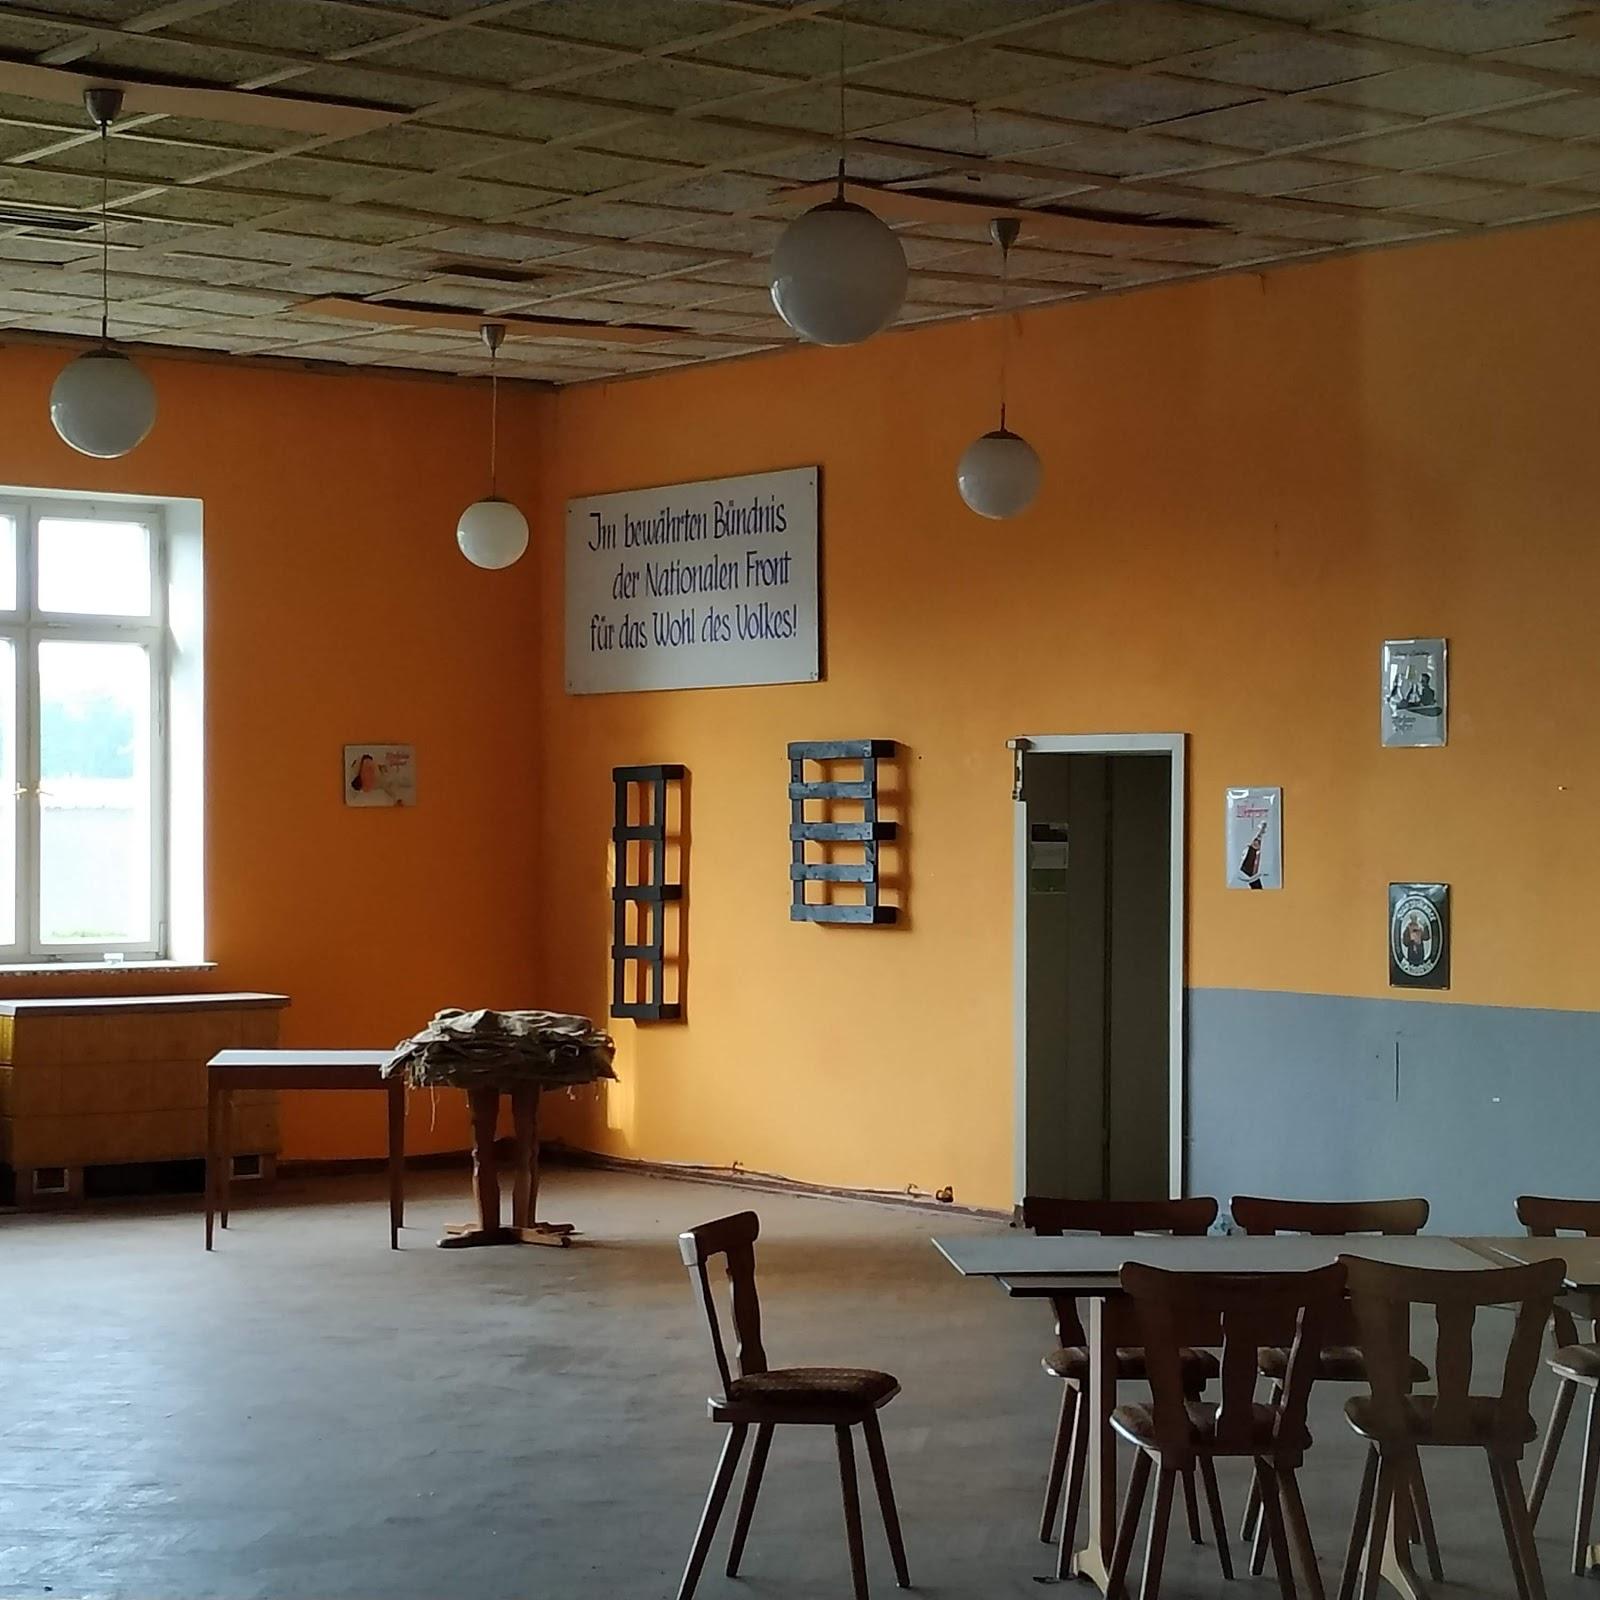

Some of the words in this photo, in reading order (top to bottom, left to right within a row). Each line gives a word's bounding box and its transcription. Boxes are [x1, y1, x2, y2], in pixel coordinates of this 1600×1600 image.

[624, 506, 707, 548] bewährten
[713, 494, 787, 539] Bündnis
[612, 563, 640, 600] der
[646, 554, 739, 597] Nationalen
[746, 550, 792, 588] Front
[590, 613, 615, 652] für
[619, 613, 648, 649] das
[652, 608, 695, 647] Wohl
[701, 605, 731, 642] des
[736, 601, 798, 641] Volkes!
